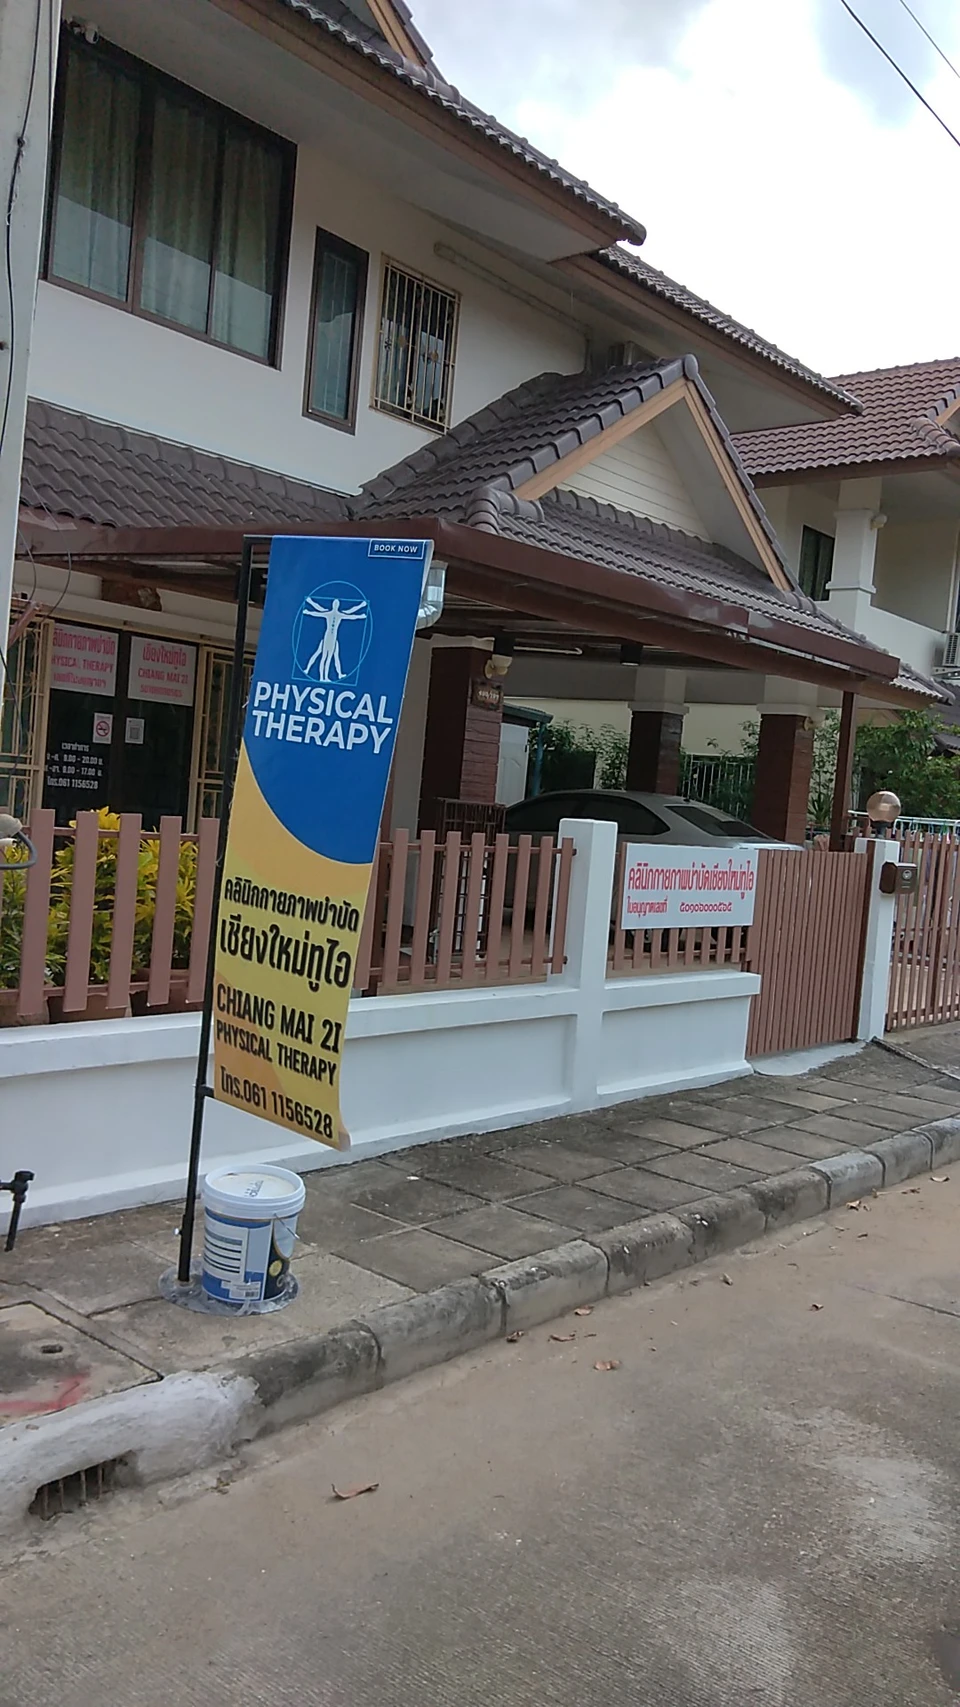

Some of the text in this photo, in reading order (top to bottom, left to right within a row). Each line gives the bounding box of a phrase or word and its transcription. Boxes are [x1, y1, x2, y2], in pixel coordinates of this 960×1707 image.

[374, 544, 418, 553] BOOK NOW
[83, 659, 114, 673] THERAPY
[138, 667, 165, 681] CHIANG
[166, 672, 180, 683] MAI
[253, 681, 394, 725] PHYSICAL
[251, 709, 392, 755] THERAPY
[71, 779, 99, 790] 1156528
[627, 859, 755, 900] คลินิกกายภาพบำบัดเชียงใหม่ทูไอ
[224, 877, 360, 933] คลินิกกายภาพบำบัด
[220, 914, 352, 993] เชียงใหม่ทูไอ
[216, 983, 276, 1031] CHIANG
[280, 1004, 315, 1045] MAI
[216, 1019, 337, 1087] PHYSICAL THERAPY
[220, 1065, 333, 1140] โทร.061 1156528
